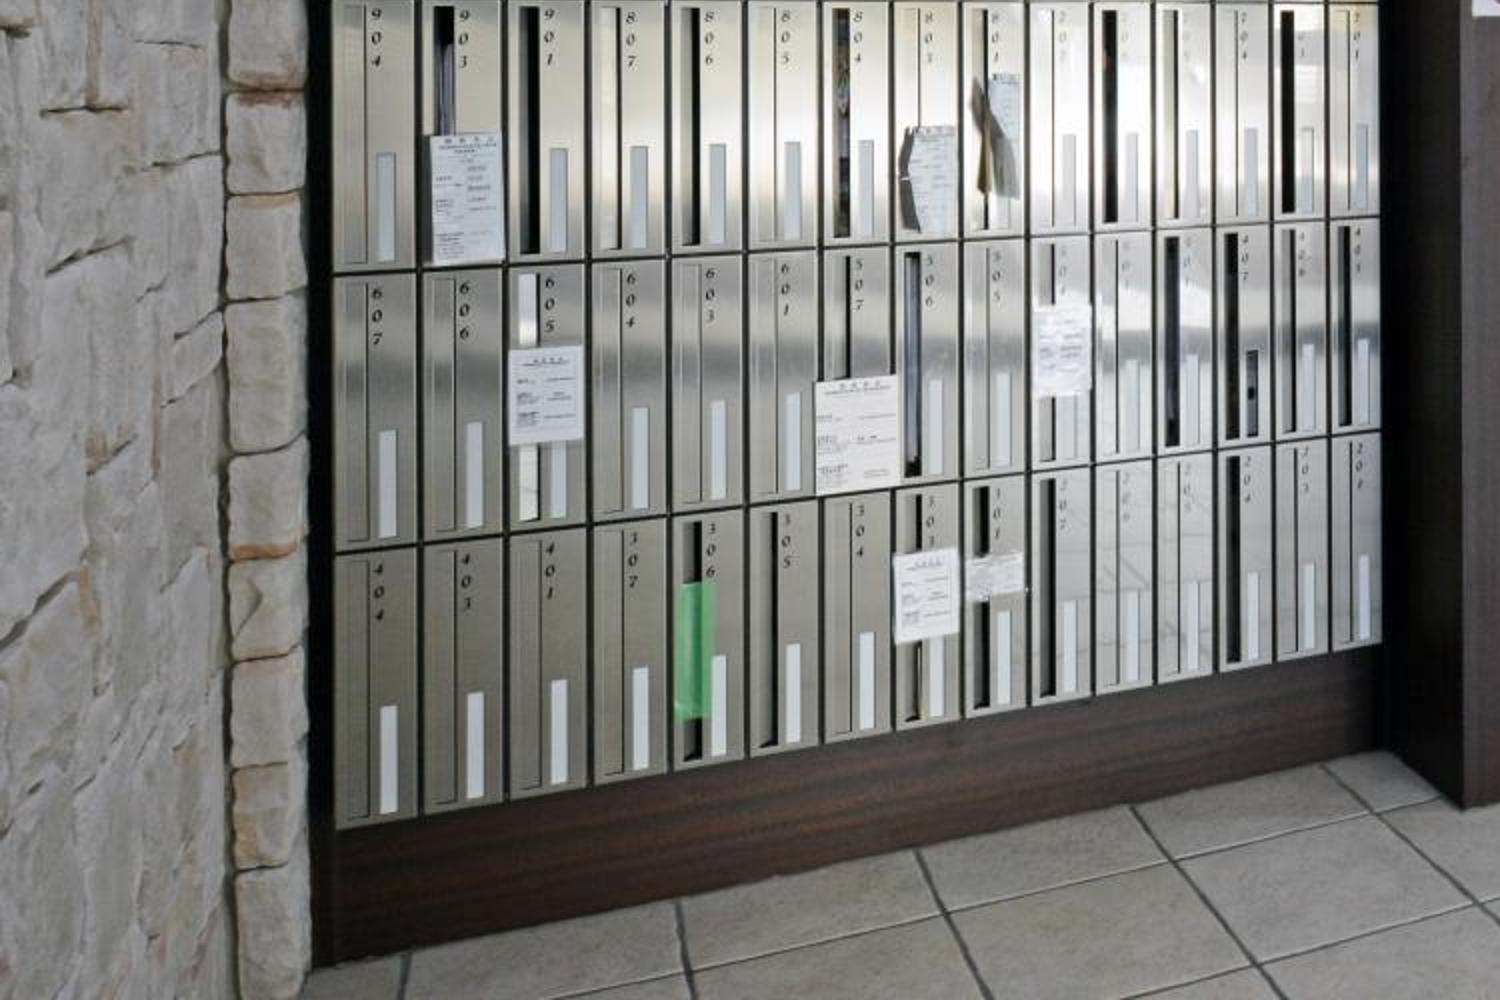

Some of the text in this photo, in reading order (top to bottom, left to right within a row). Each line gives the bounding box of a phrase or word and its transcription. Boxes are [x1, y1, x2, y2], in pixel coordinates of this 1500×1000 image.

[370, 8, 382, 68] 904
[458, 9, 470, 69] 903
[544, 8, 555, 67] 901
[625, 11, 637, 68] 807
[704, 10, 715, 66] 806
[781, 10, 791, 65] 805
[853, 10, 863, 64] 804
[459, 281, 470, 341] 606
[545, 276, 555, 333] 605
[625, 271, 637, 329] 604
[705, 266, 716, 323] 603
[781, 263, 791, 317] 601
[854, 258, 863, 312] 507
[371, 286, 383, 345] 607
[705, 522, 716, 578] 306
[855, 504, 865, 558] 304
[373, 563, 385, 621] 404
[460, 552, 472, 610] 403
[545, 542, 555, 600] 401
